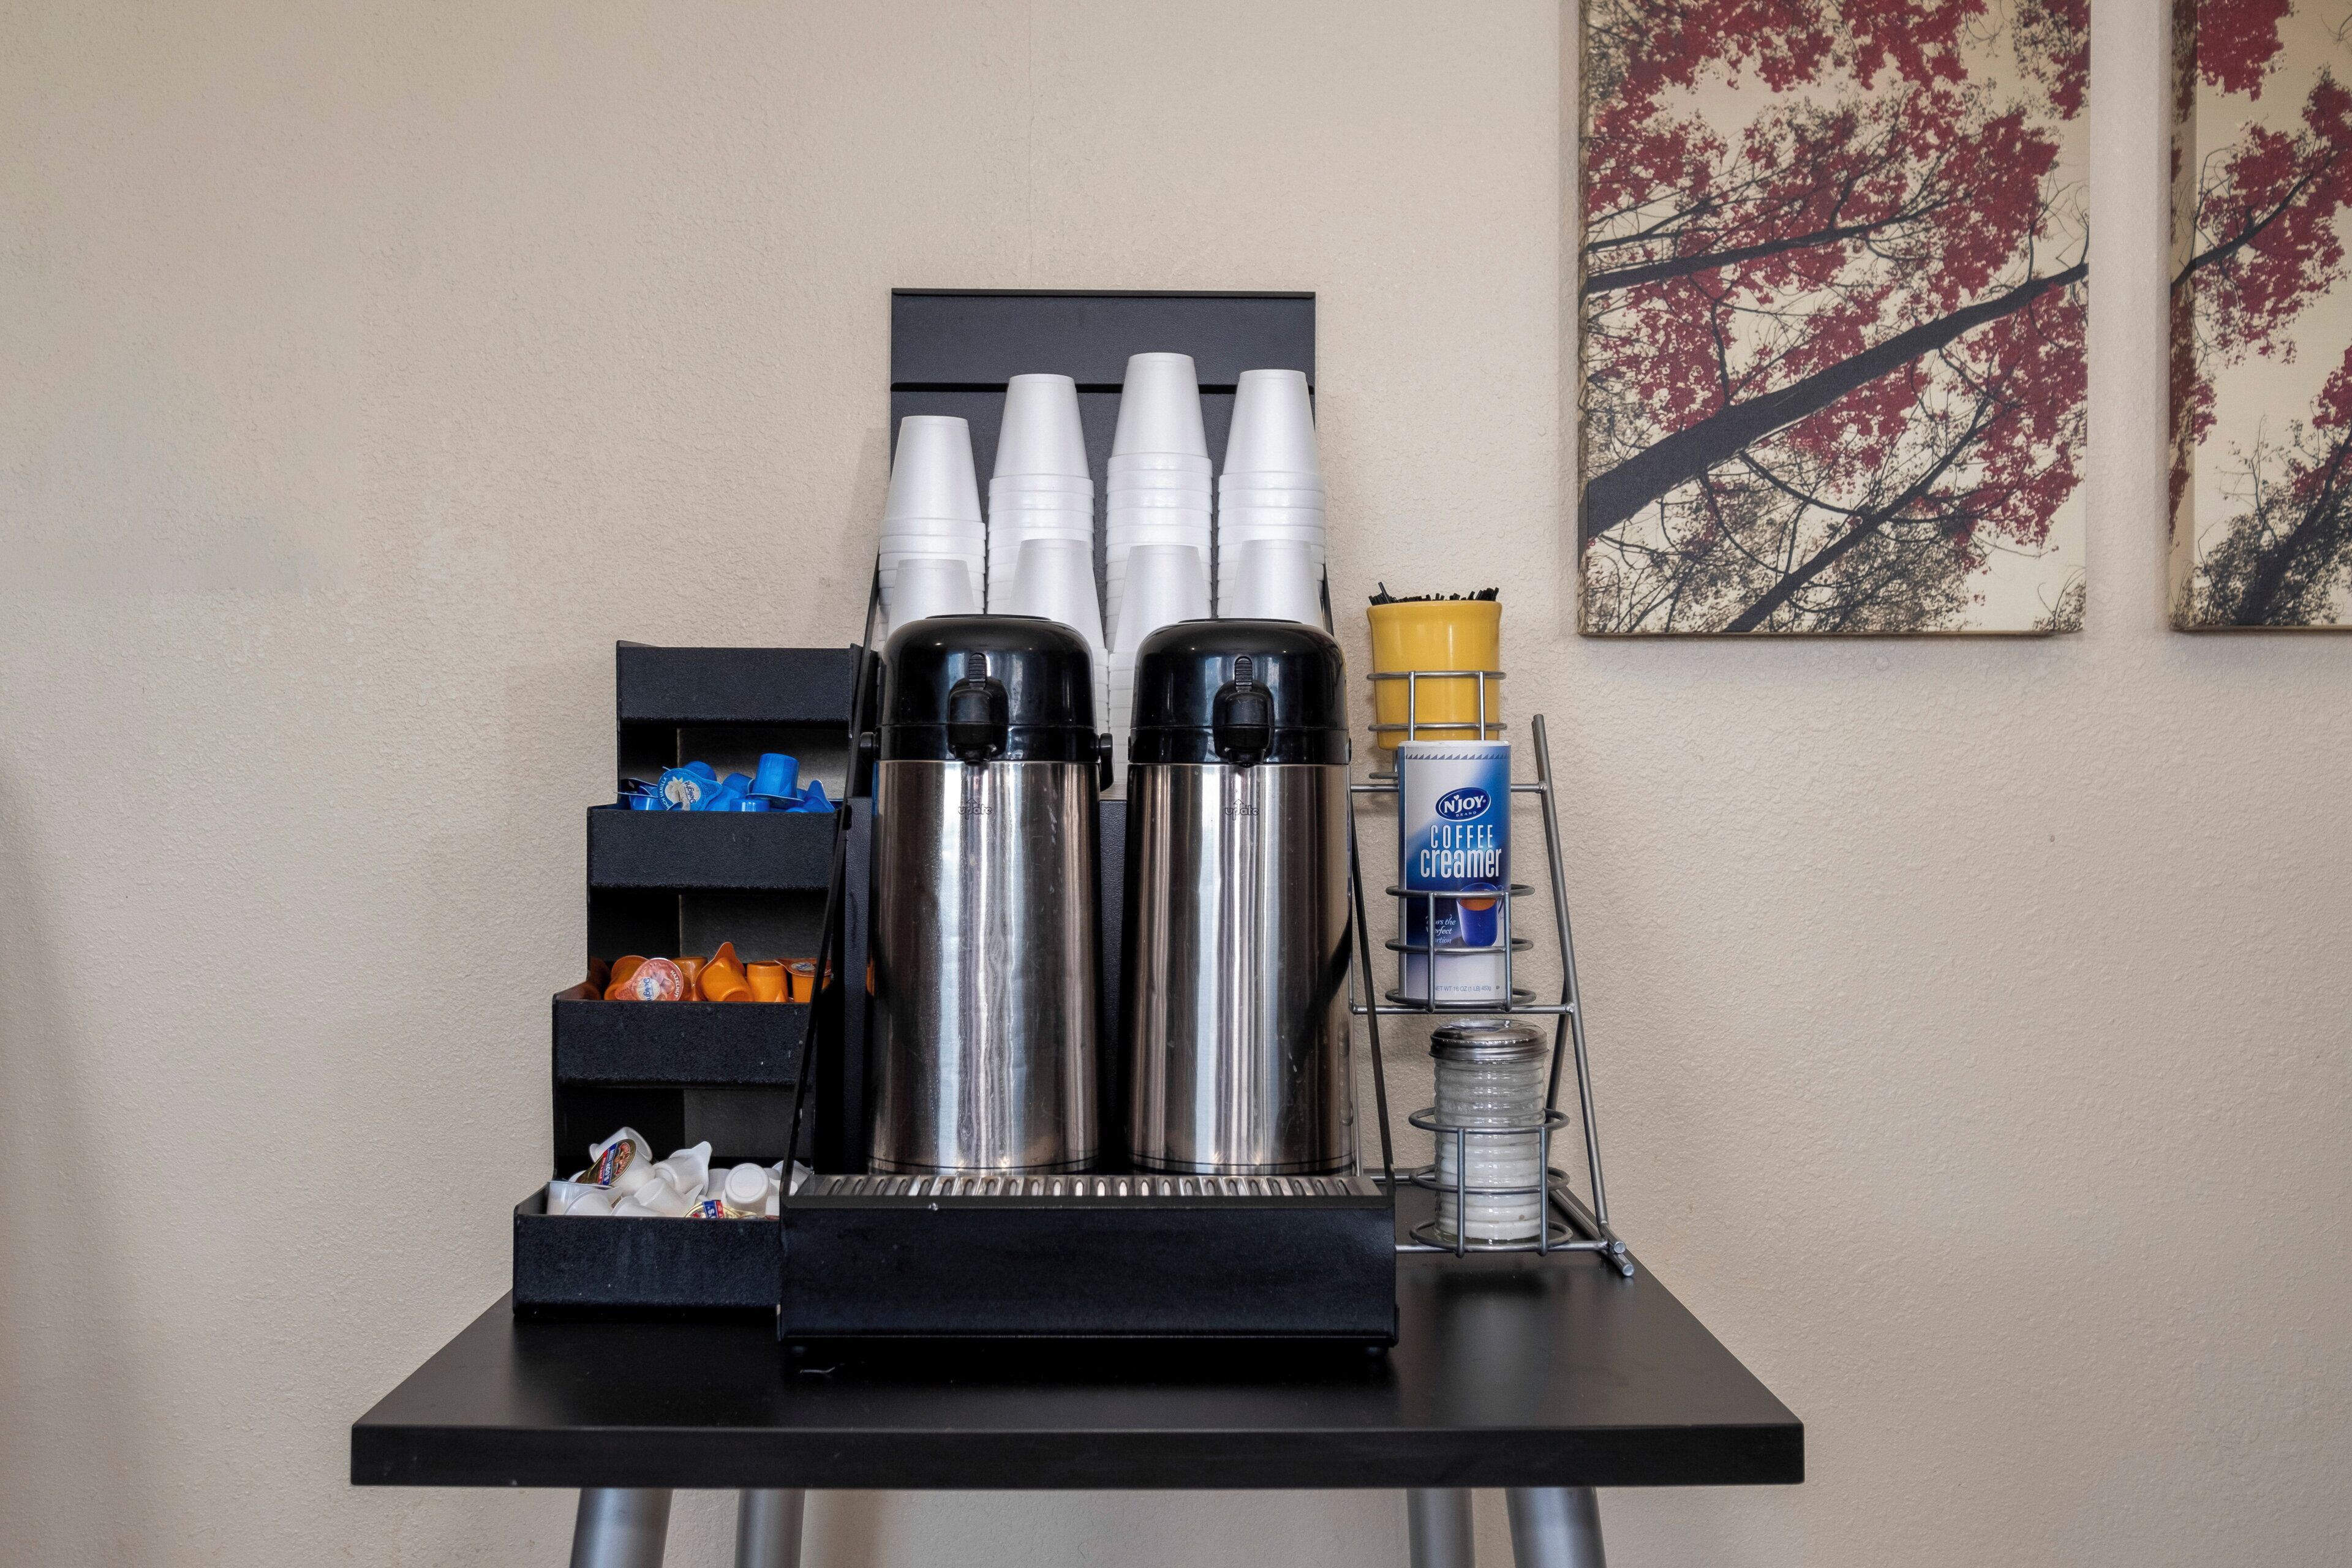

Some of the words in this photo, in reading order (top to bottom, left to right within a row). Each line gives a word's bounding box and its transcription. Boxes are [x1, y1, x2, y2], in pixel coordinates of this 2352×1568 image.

[659, 777, 668, 796] VANILLA
[685, 780, 696, 804] Delight
[1224, 799, 1259, 821] update
[1430, 824, 1493, 849] COFFEE
[1420, 848, 1502, 878] creamer
[1445, 917, 1456, 925] the
[670, 970, 680, 998] HAZELNUT
